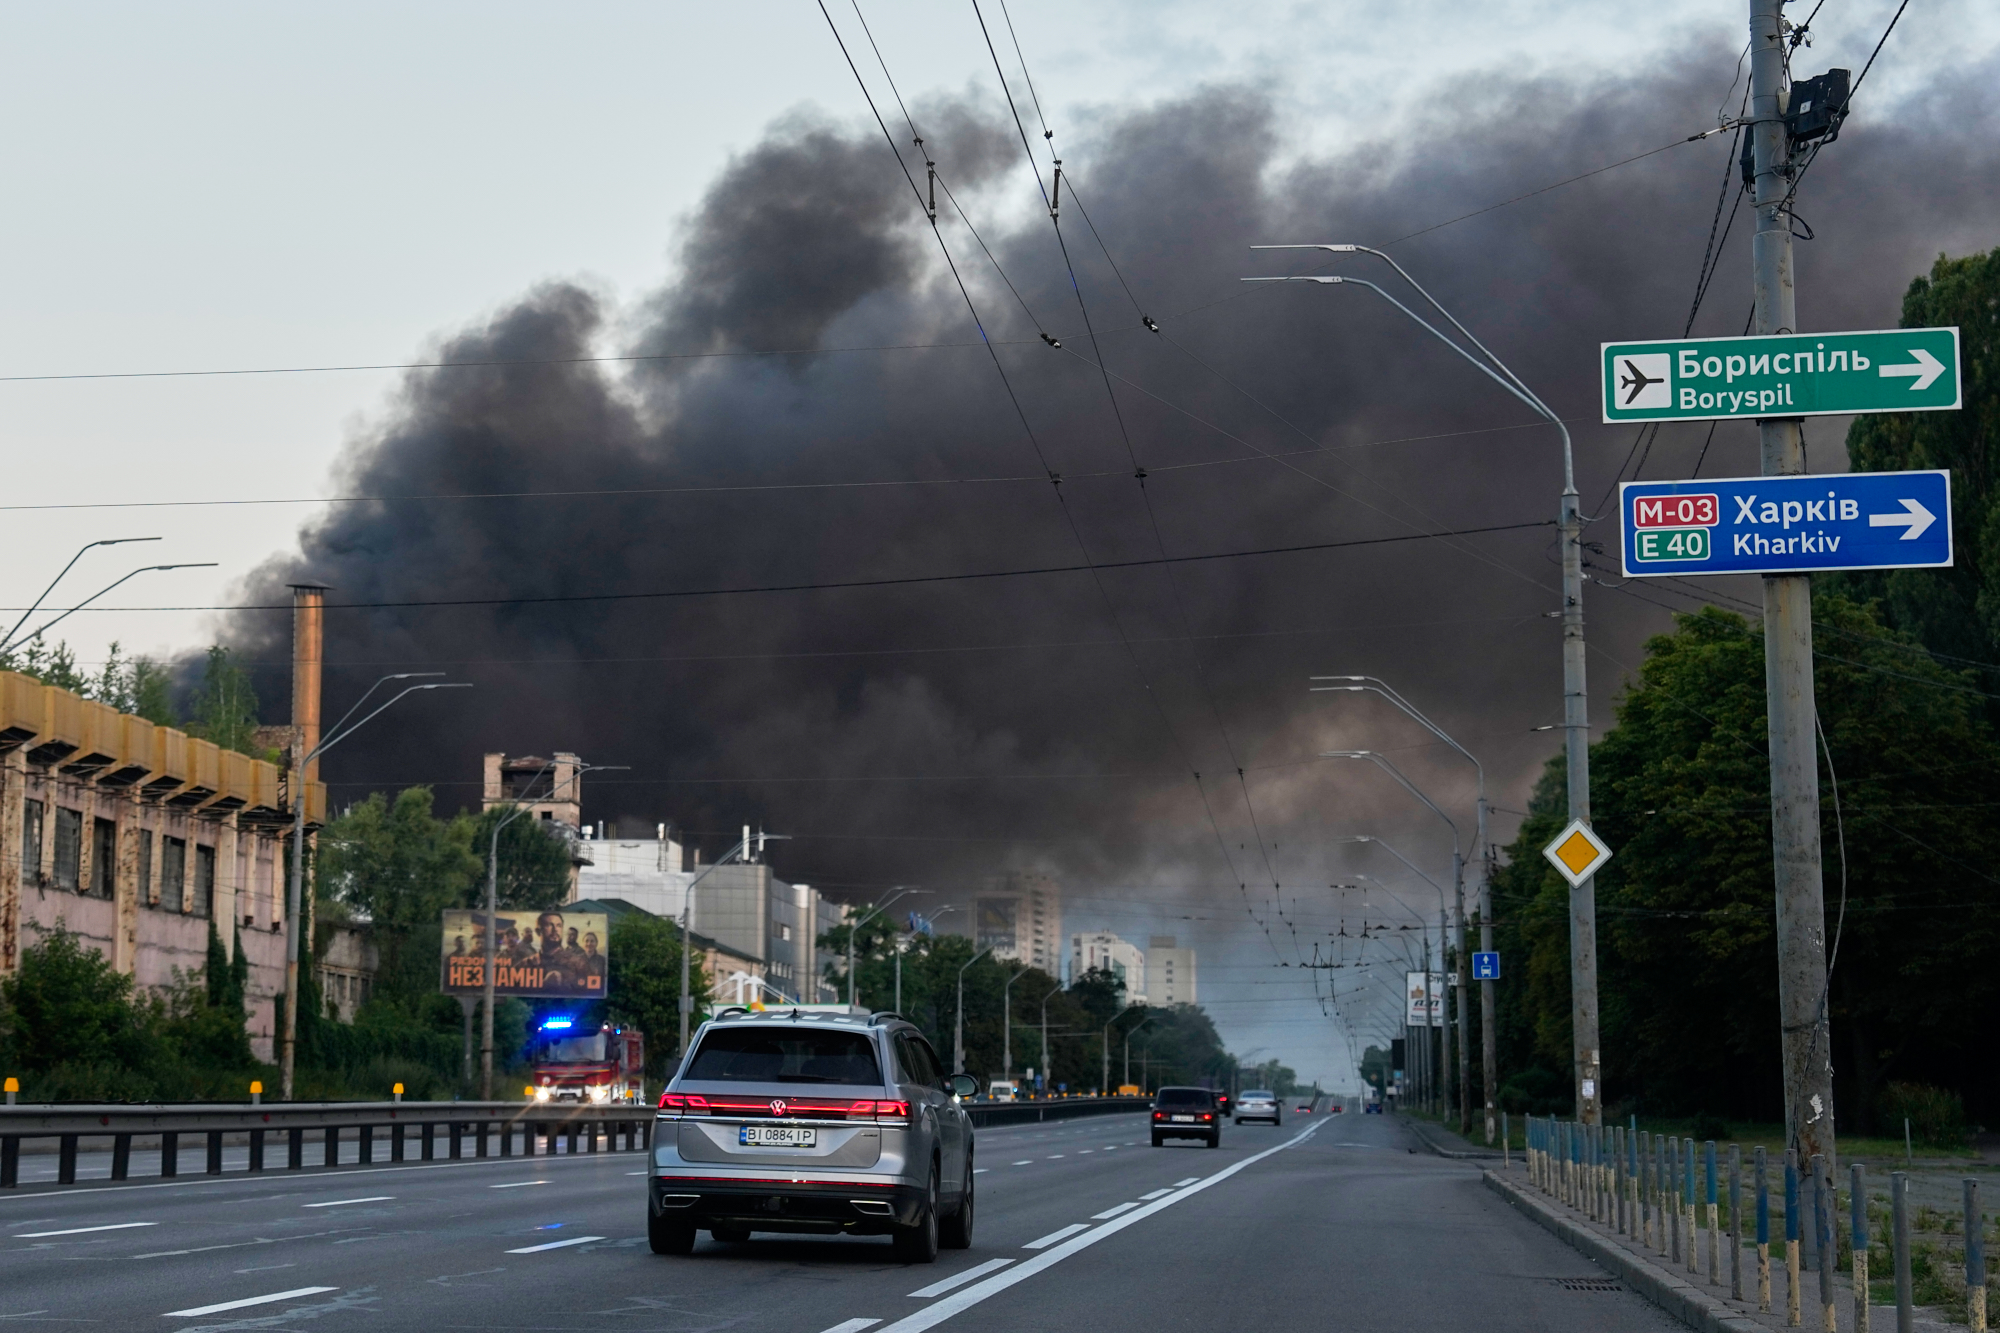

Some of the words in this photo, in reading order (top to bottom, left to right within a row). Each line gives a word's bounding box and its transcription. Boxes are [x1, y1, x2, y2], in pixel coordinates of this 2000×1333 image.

[1678, 342, 1870, 383] Бориспіль
[1679, 383, 1793, 412] Boryspil
[1733, 491, 1859, 529] Харків
[1642, 534, 1659, 557] E
[1666, 533, 1703, 556] 40
[1733, 530, 1841, 556] Kharkiv
[449, 966, 543, 988] НЕЗАМНІ
[765, 1129, 793, 1141] 0884
